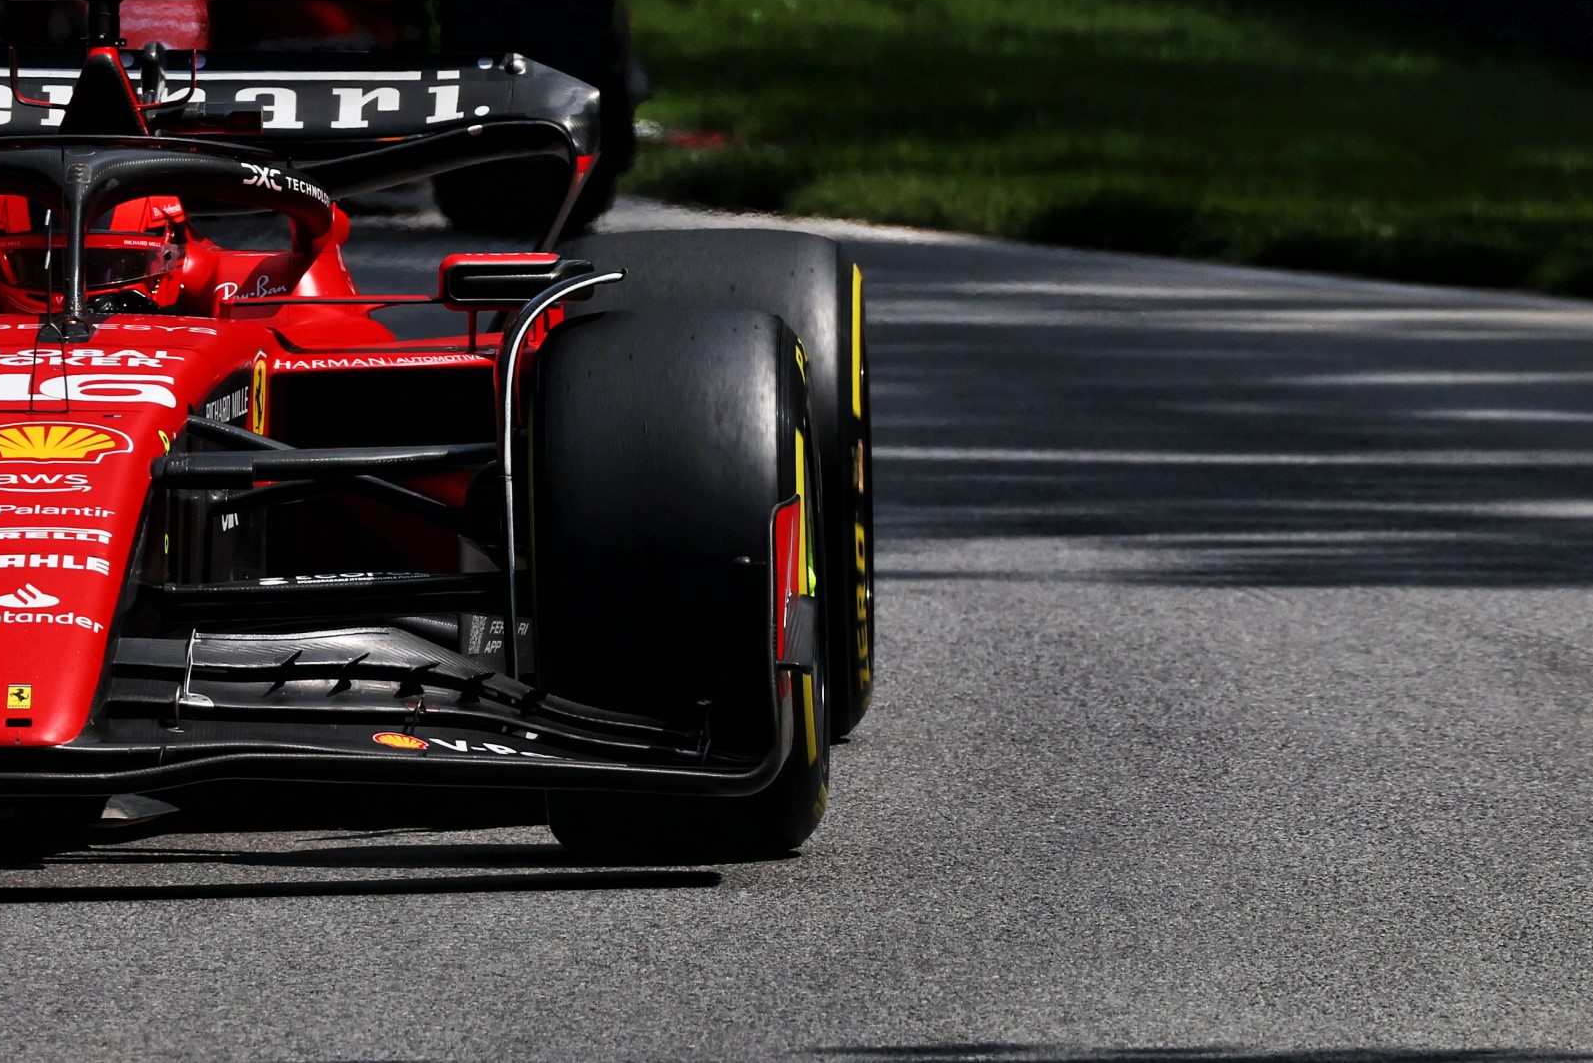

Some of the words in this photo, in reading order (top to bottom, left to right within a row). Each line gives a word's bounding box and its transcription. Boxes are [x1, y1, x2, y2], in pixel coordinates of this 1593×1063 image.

[241, 162, 283, 191] DXC
[273, 357, 385, 370] HARMAN
[396, 354, 485, 364] AUTOMOTIVE
[483, 640, 503, 654] APP
